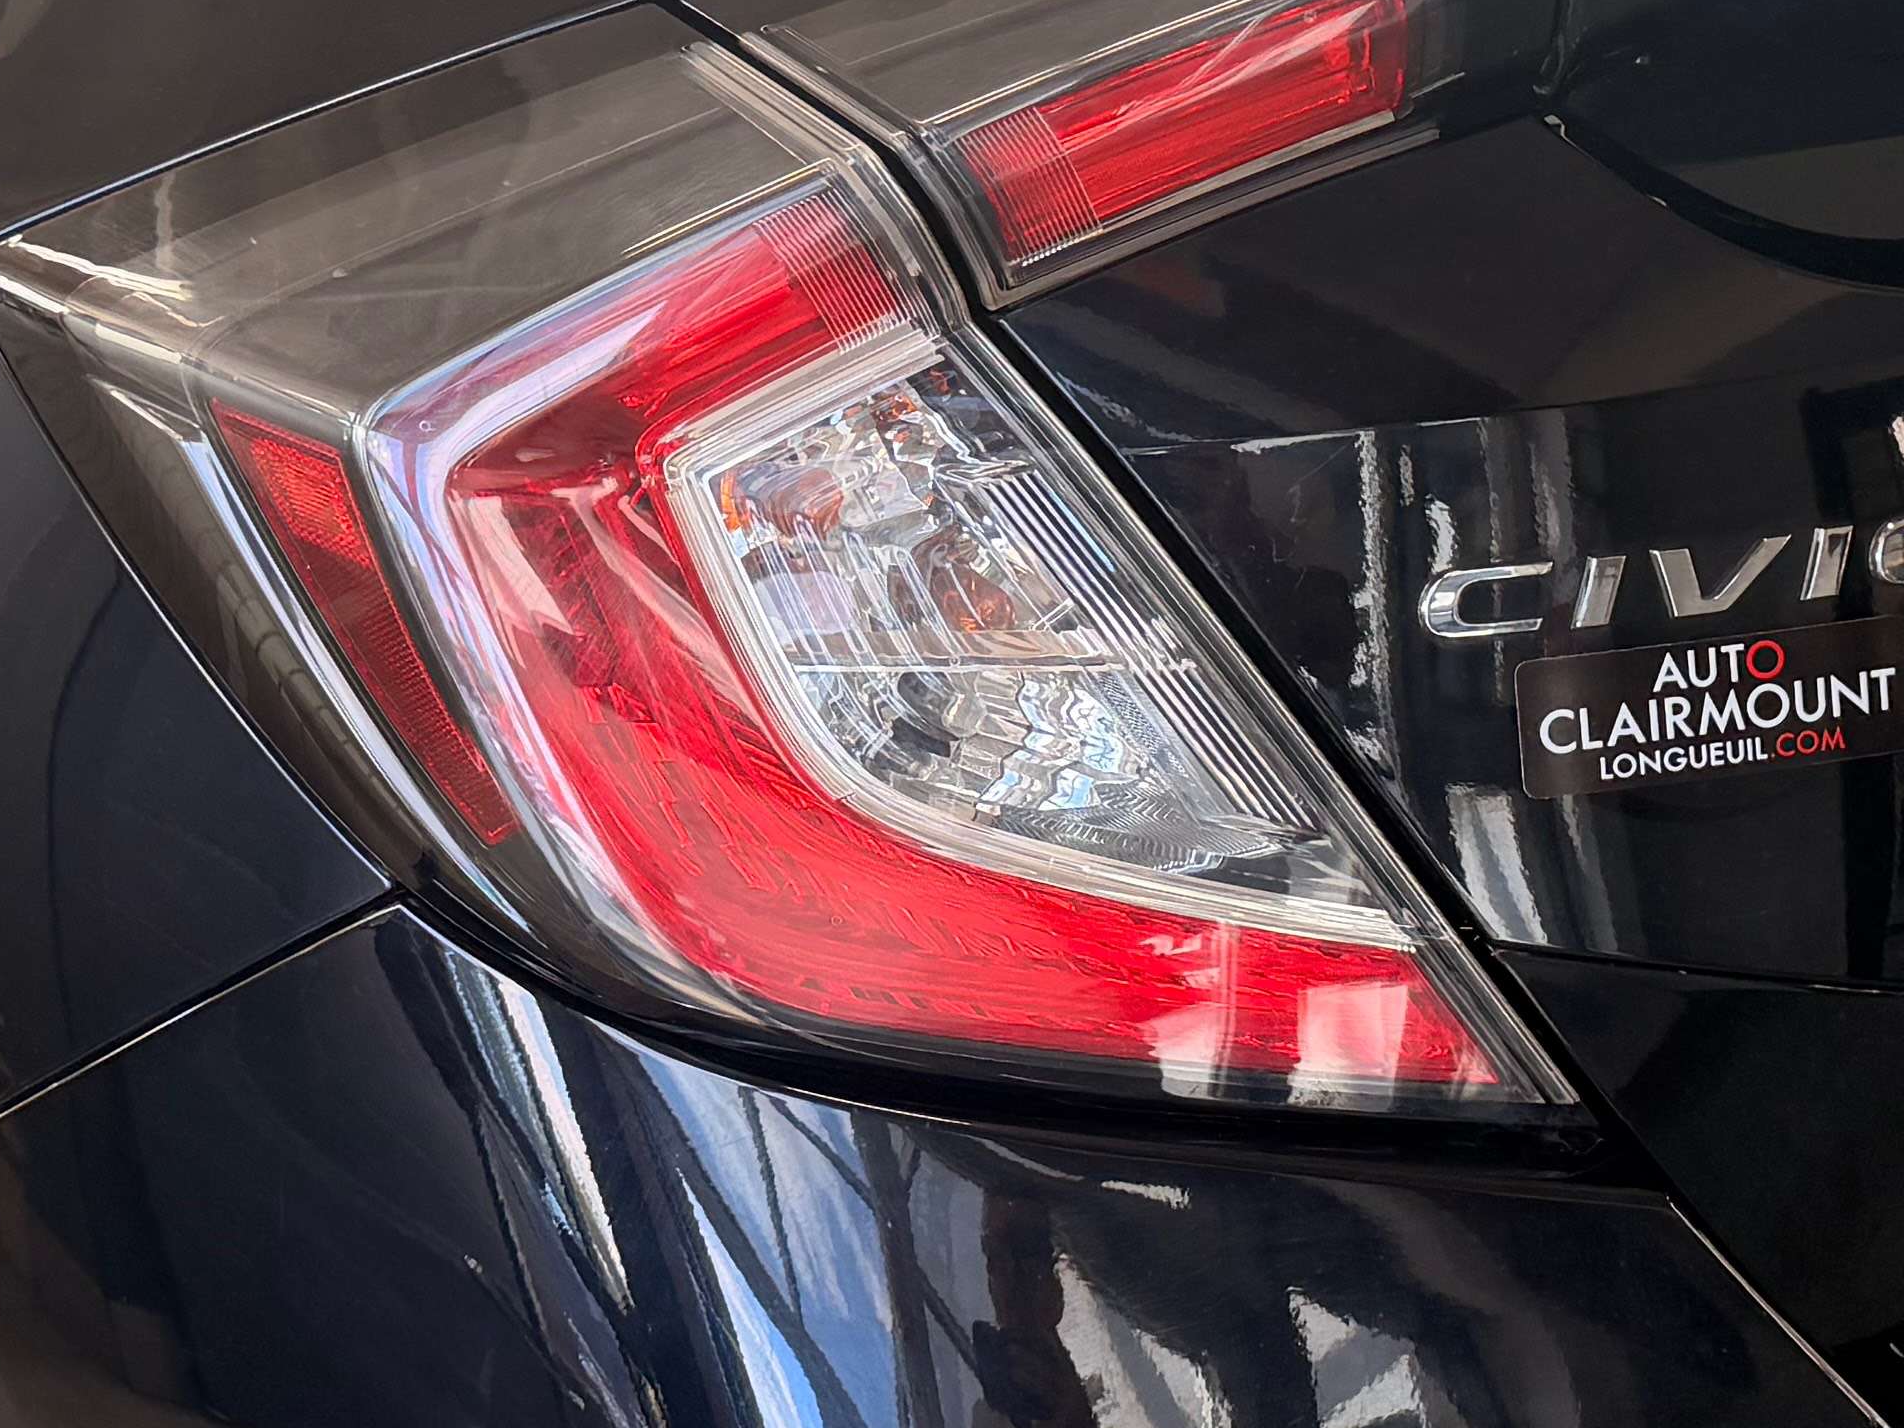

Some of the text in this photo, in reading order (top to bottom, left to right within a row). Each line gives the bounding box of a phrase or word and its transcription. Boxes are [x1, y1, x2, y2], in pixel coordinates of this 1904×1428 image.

[1652, 638, 1785, 693] AUTO
[1538, 666, 1897, 756] CLAIRMOUNT
[1599, 725, 1847, 781] LONGUEUIL.COM
